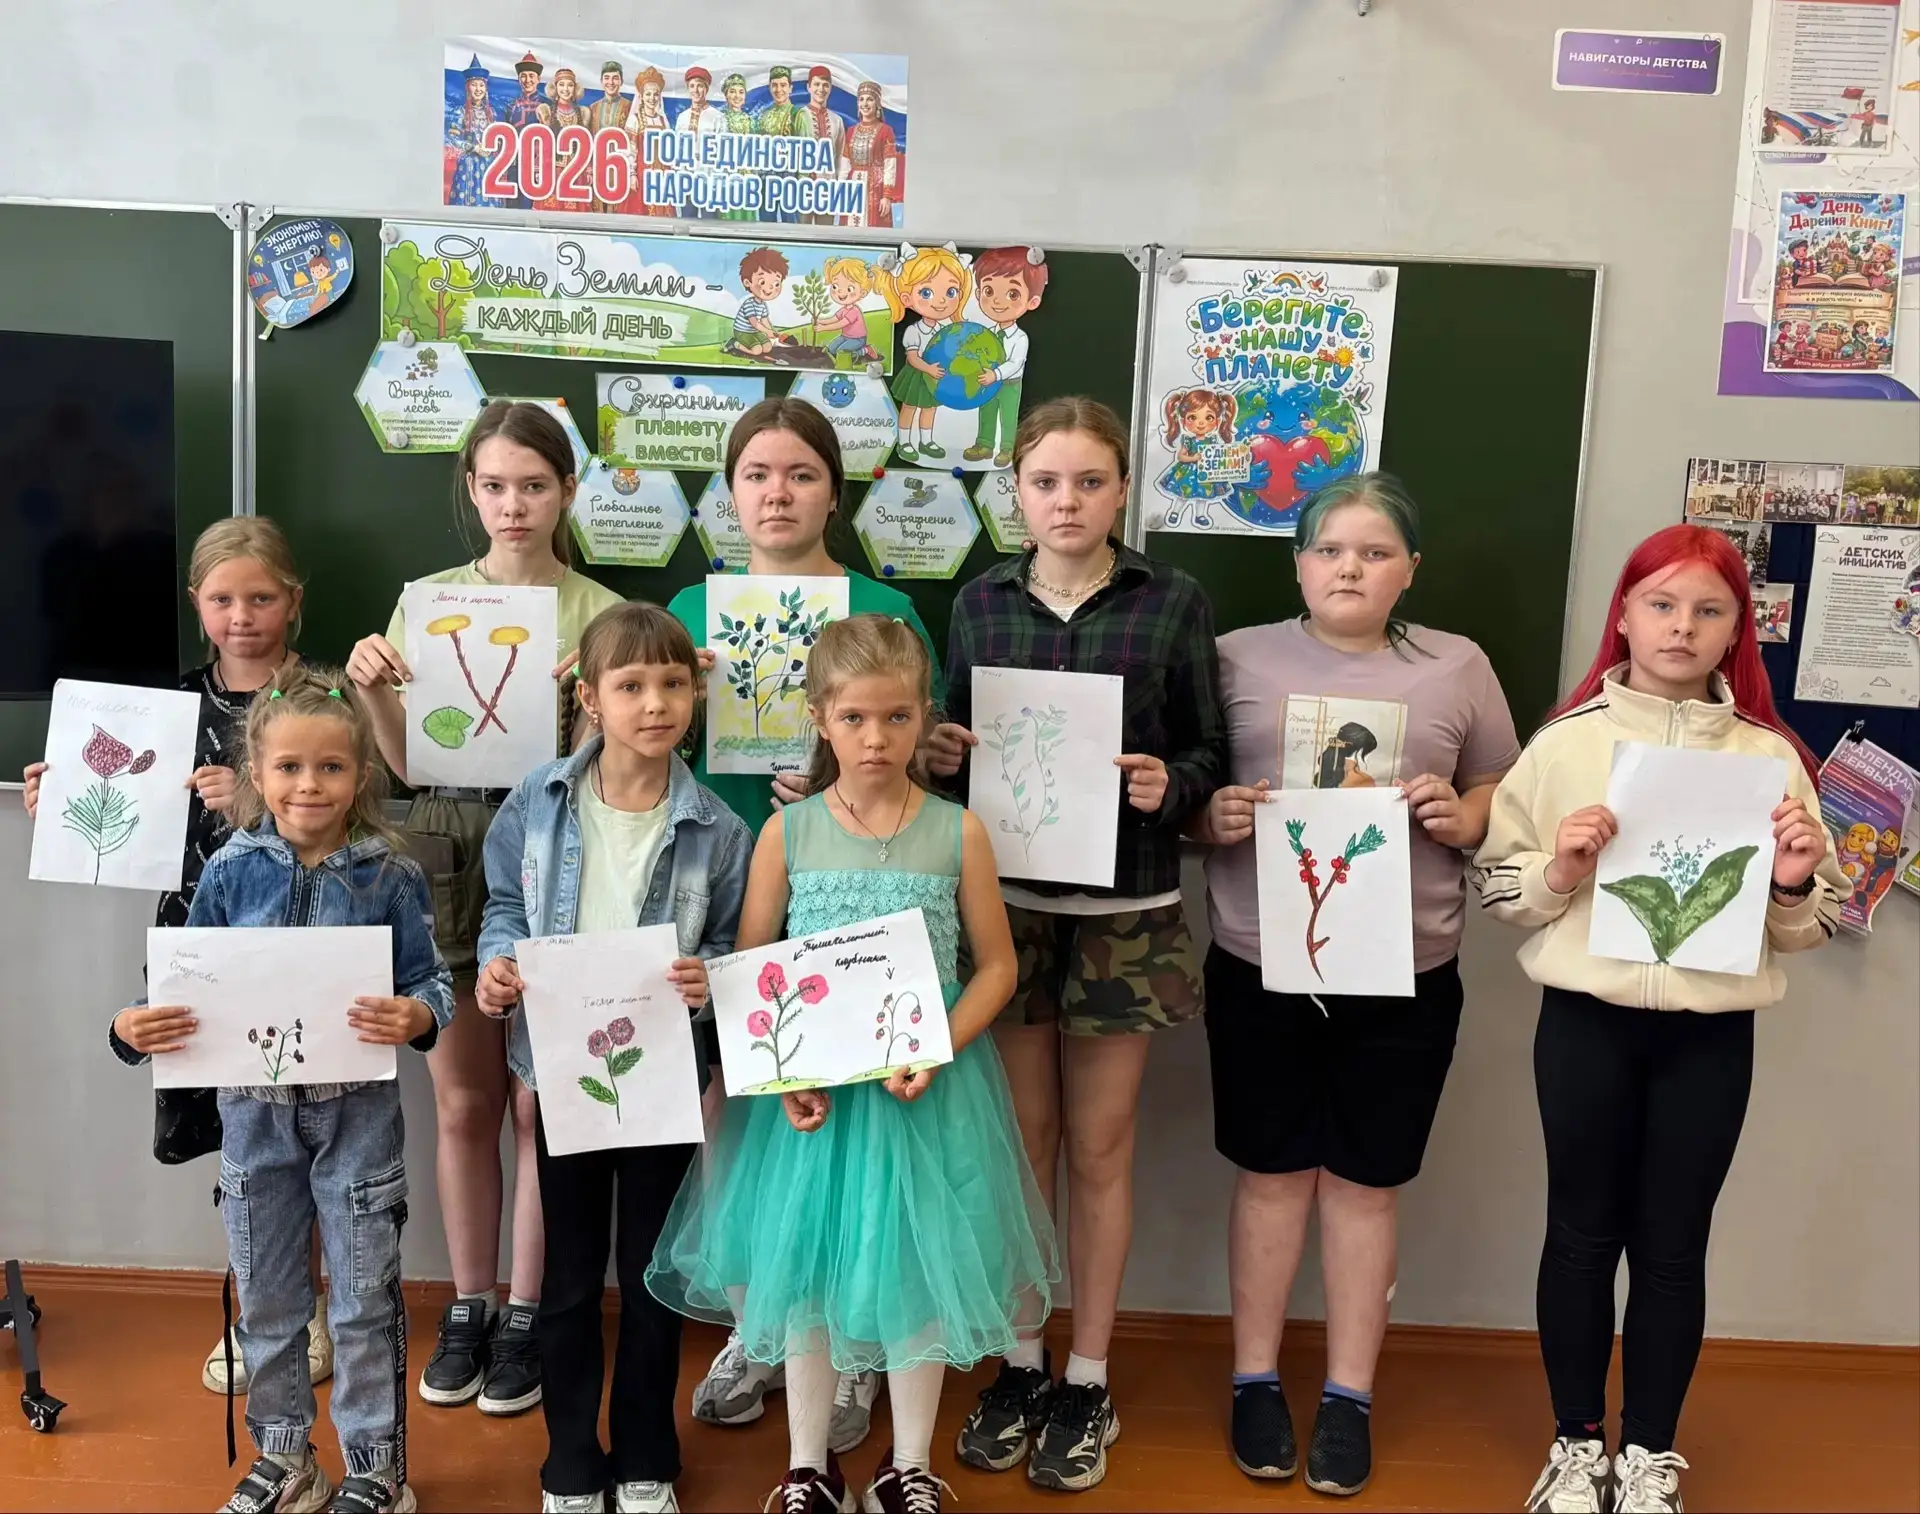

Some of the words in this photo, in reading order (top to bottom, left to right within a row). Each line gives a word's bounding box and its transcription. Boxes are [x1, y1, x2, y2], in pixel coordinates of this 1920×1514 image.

[1569, 52, 1651, 66] НАВИГАТОРЫ
[1653, 57, 1708, 70] ДЕТСТВА
[482, 122, 631, 203] 2026
[644, 130, 698, 167] ГОД
[702, 134, 835, 173] ЕДИНСТВА
[644, 173, 760, 210] НАРОДОВ
[763, 180, 864, 215] РОССИИ
[1821, 199, 1865, 216] День
[264, 220, 321, 248] ЭКОНОМЬТЕ
[1789, 214, 1847, 231] Дарения
[1850, 213, 1894, 233] Книг!
[273, 229, 324, 256] ЭНЕРГИЮ!
[428, 234, 549, 292] День
[556, 240, 697, 298] Земли
[478, 306, 597, 338] КАЖДЫЙ
[602, 313, 673, 341] ДЕНЬ
[388, 380, 453, 404] Вырубка
[607, 375, 745, 421] Сохраним
[404, 397, 442, 413] лесов
[634, 417, 727, 442] планету
[634, 439, 723, 463] вместе!
[1204, 456, 1244, 471] ЗЕМЛИ!
[590, 495, 663, 514] Глобальное
[590, 518, 664, 530] потепление
[876, 505, 956, 530] Загрязнение
[901, 524, 936, 545] воды
[1863, 534, 1889, 542] ЦЕНТР
[1839, 557, 1907, 570] ИНИЦИАТИВ
[1844, 546, 1904, 560] ДЕТСКИХ
[396, 1314, 406, 1373] FASHION
[395, 1423, 405, 1483] FASHION
